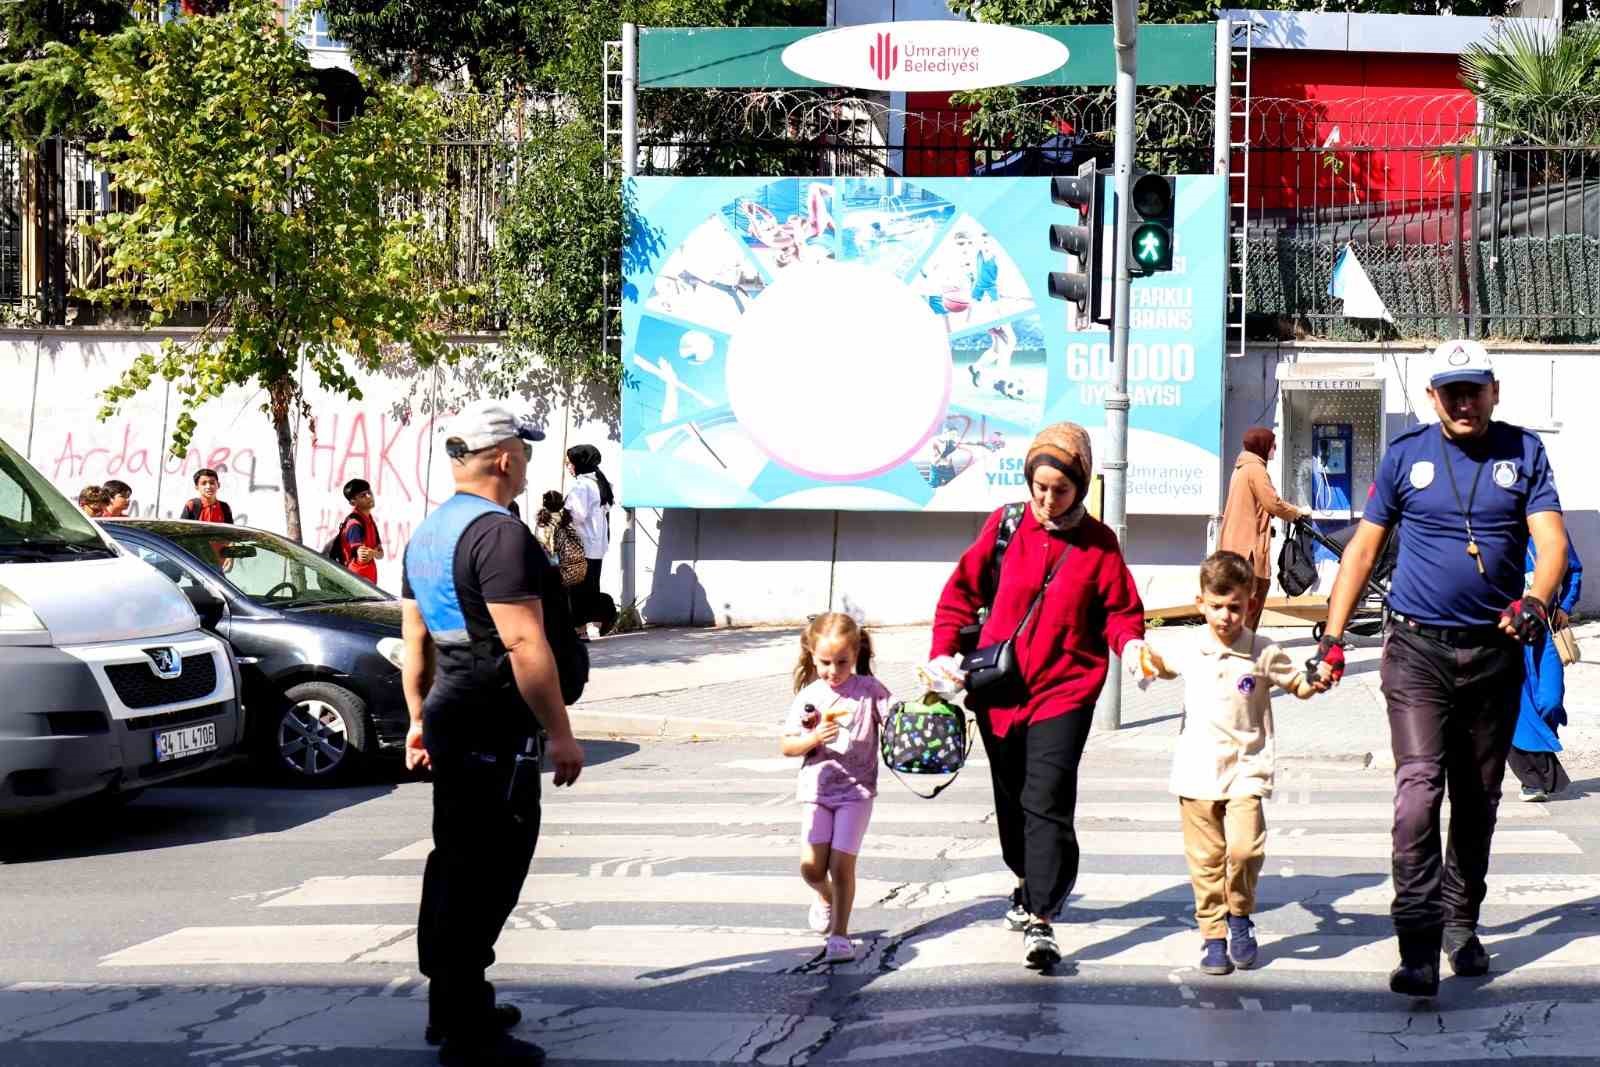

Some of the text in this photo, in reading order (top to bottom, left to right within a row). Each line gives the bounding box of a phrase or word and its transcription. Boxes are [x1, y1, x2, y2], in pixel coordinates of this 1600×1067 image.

[904, 39, 980, 60] Ümraniye
[904, 58, 979, 76] Belediyesi
[1308, 379, 1361, 389] TELEFON
[54, 423, 153, 480] Arda
[161, 733, 174, 753] 34
[177, 731, 189, 750] TL
